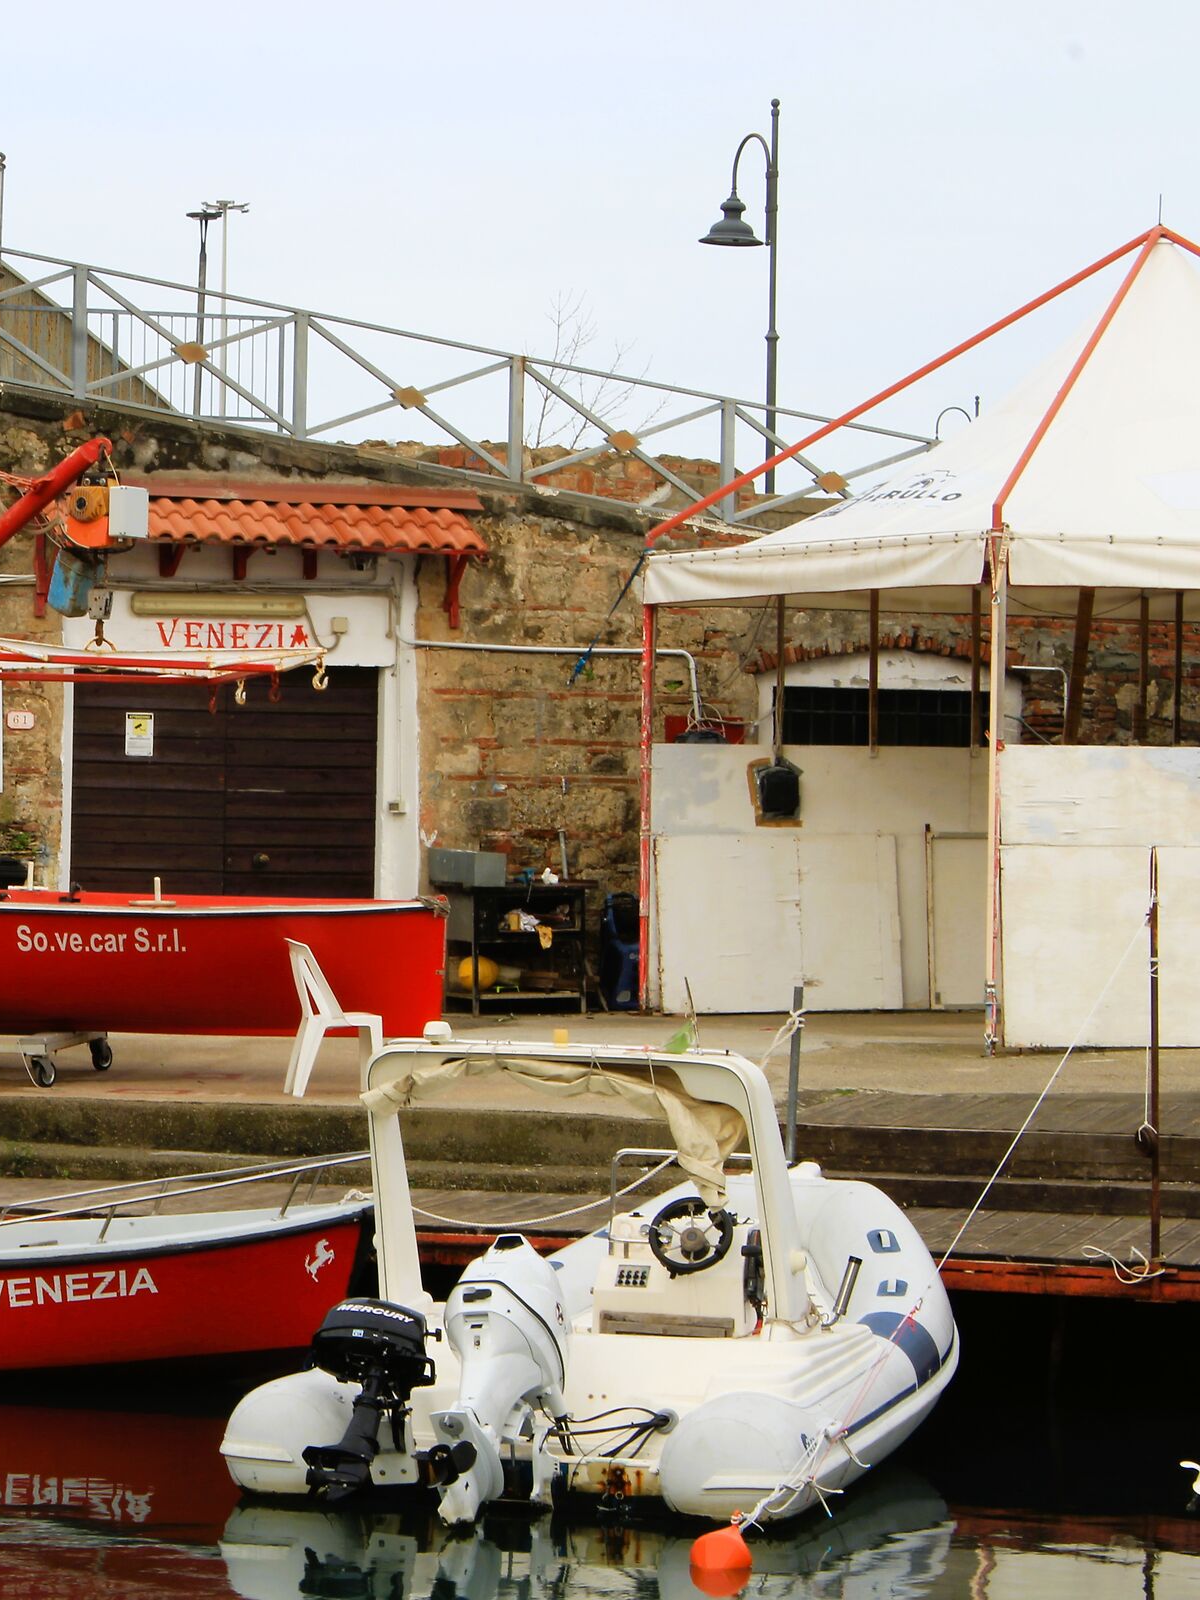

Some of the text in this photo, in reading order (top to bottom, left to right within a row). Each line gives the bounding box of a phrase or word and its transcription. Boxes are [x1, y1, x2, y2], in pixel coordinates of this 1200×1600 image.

[156, 617, 309, 649] VENEZIA
[16, 924, 187, 952] So.ve.car S.r.l.
[336, 1303, 415, 1324] MERCURY
